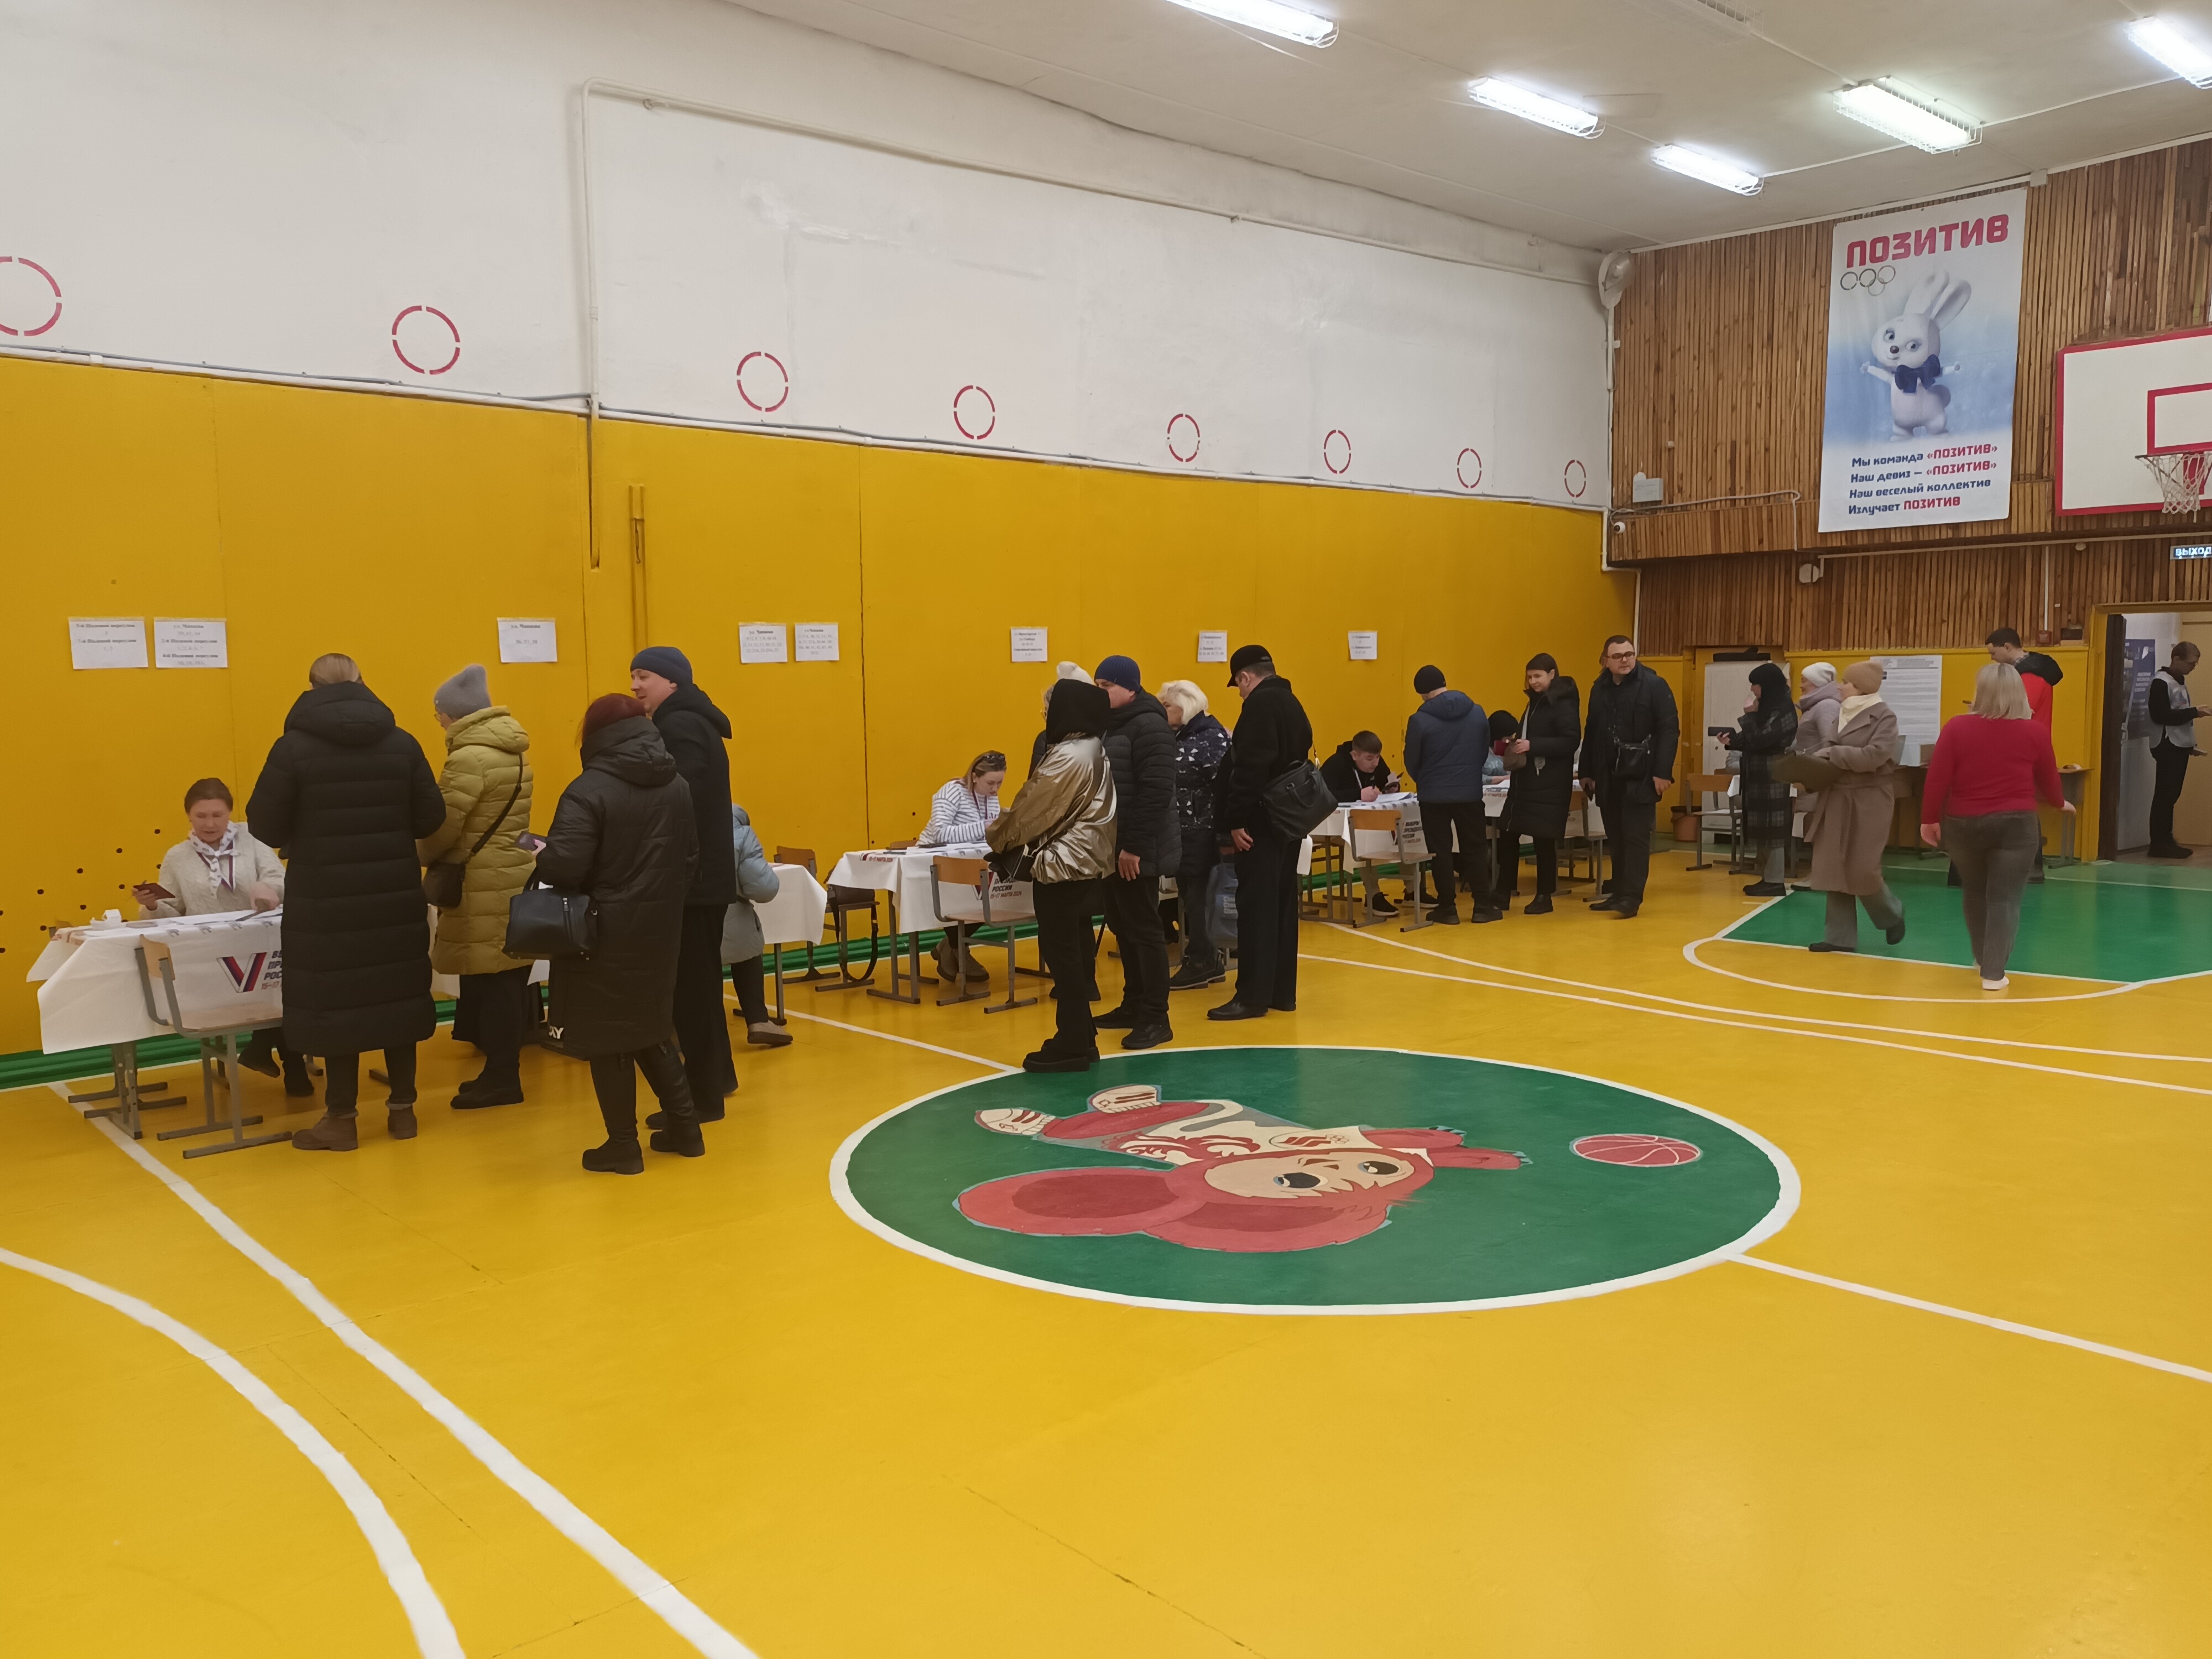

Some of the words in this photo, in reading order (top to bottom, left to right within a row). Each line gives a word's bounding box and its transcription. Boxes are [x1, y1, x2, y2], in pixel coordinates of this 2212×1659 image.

[1846, 214, 2008, 268] ПОЗИТИВ
[1852, 457, 1870, 467] Мы
[1874, 453, 1923, 465] команда
[1927, 444, 1997, 459] «ПОЗИТИВ»
[1850, 473, 1874, 483] Наш
[1877, 471, 1911, 482] девиз
[1926, 460, 1997, 476] «ПОЗИТИВ»
[1849, 489, 1873, 499] Наш
[1876, 483, 1924, 496] веселый
[1927, 479, 1991, 492] коллектив
[1848, 503, 1901, 515] Излучает
[1903, 497, 1960, 510] ПОЗИТИВ
[2176, 546, 2211, 556] ВЫХОД
